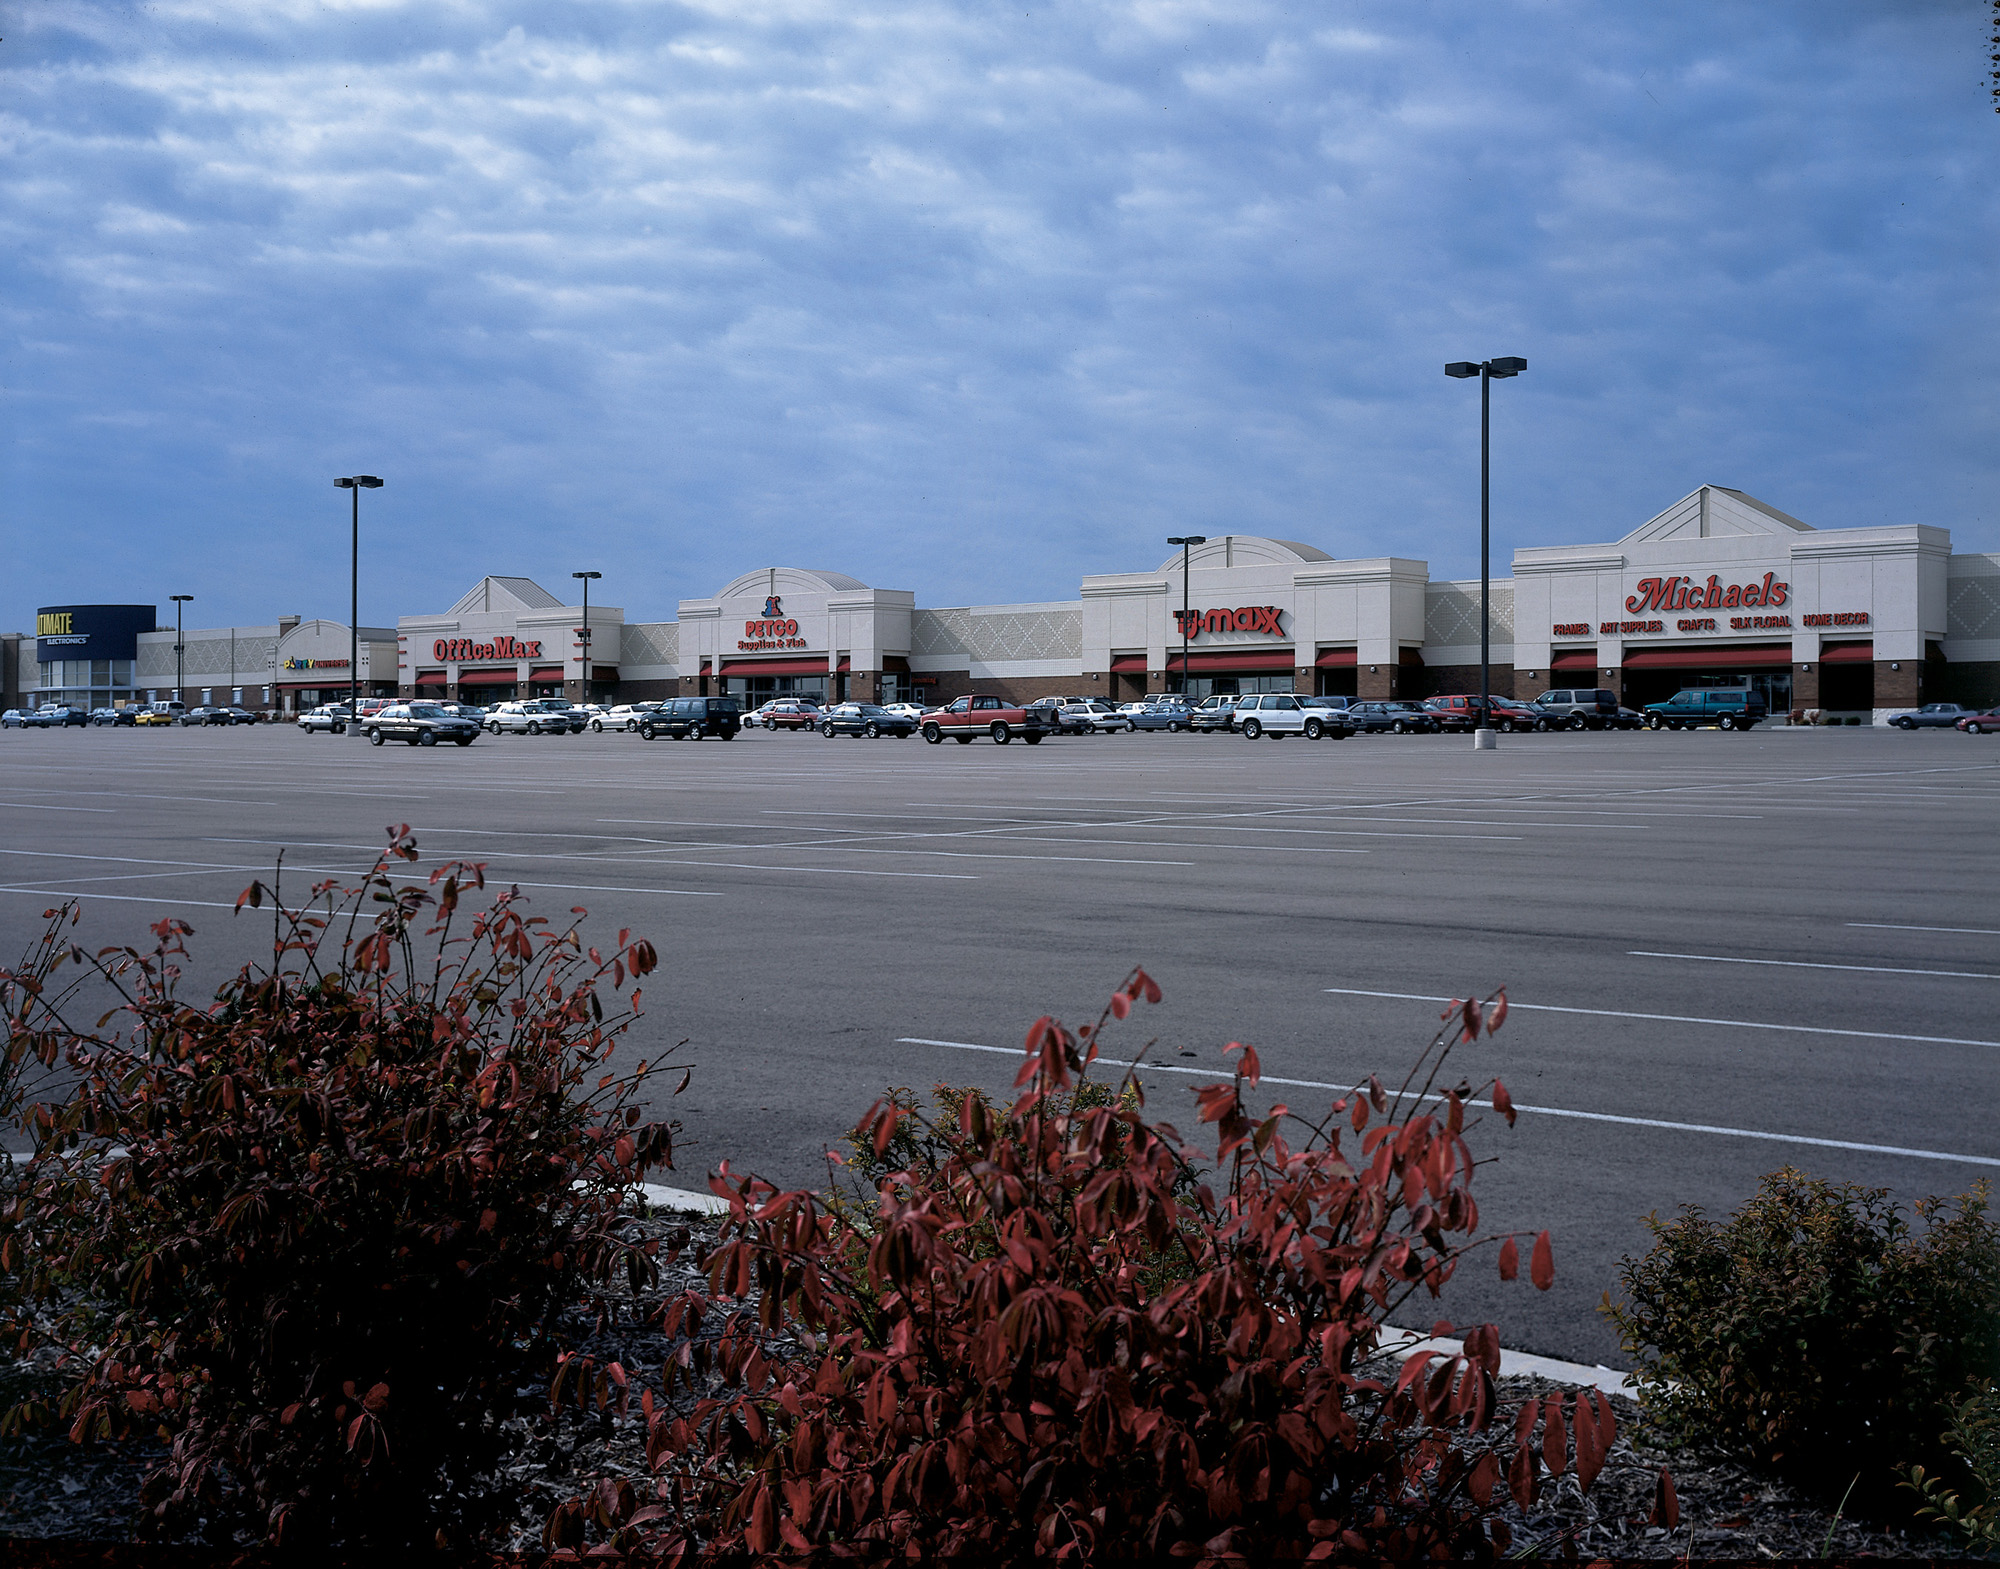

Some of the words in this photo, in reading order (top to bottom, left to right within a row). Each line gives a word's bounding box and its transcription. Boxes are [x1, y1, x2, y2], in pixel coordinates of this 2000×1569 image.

[1625, 571, 1788, 613] Michaels
[745, 618, 798, 637] PETCO
[1553, 623, 1589, 635] FRAMES
[1600, 622, 1618, 633] ART
[1620, 620, 1662, 633] SUPPLIES
[1677, 618, 1715, 631] CRAFTS
[1730, 616, 1752, 629] SILK
[1753, 615, 1791, 628] FLORAL
[1803, 613, 1832, 626] HOME
[1833, 612, 1868, 625] DECOR
[47, 637, 87, 645] ELECTRONICS
[433, 636, 541, 661] OfficeMax
[737, 640, 775, 651] Supplies
[776, 639, 784, 648] &
[785, 638, 806, 647] Fish
[315, 659, 349, 668] UNIVERSE
